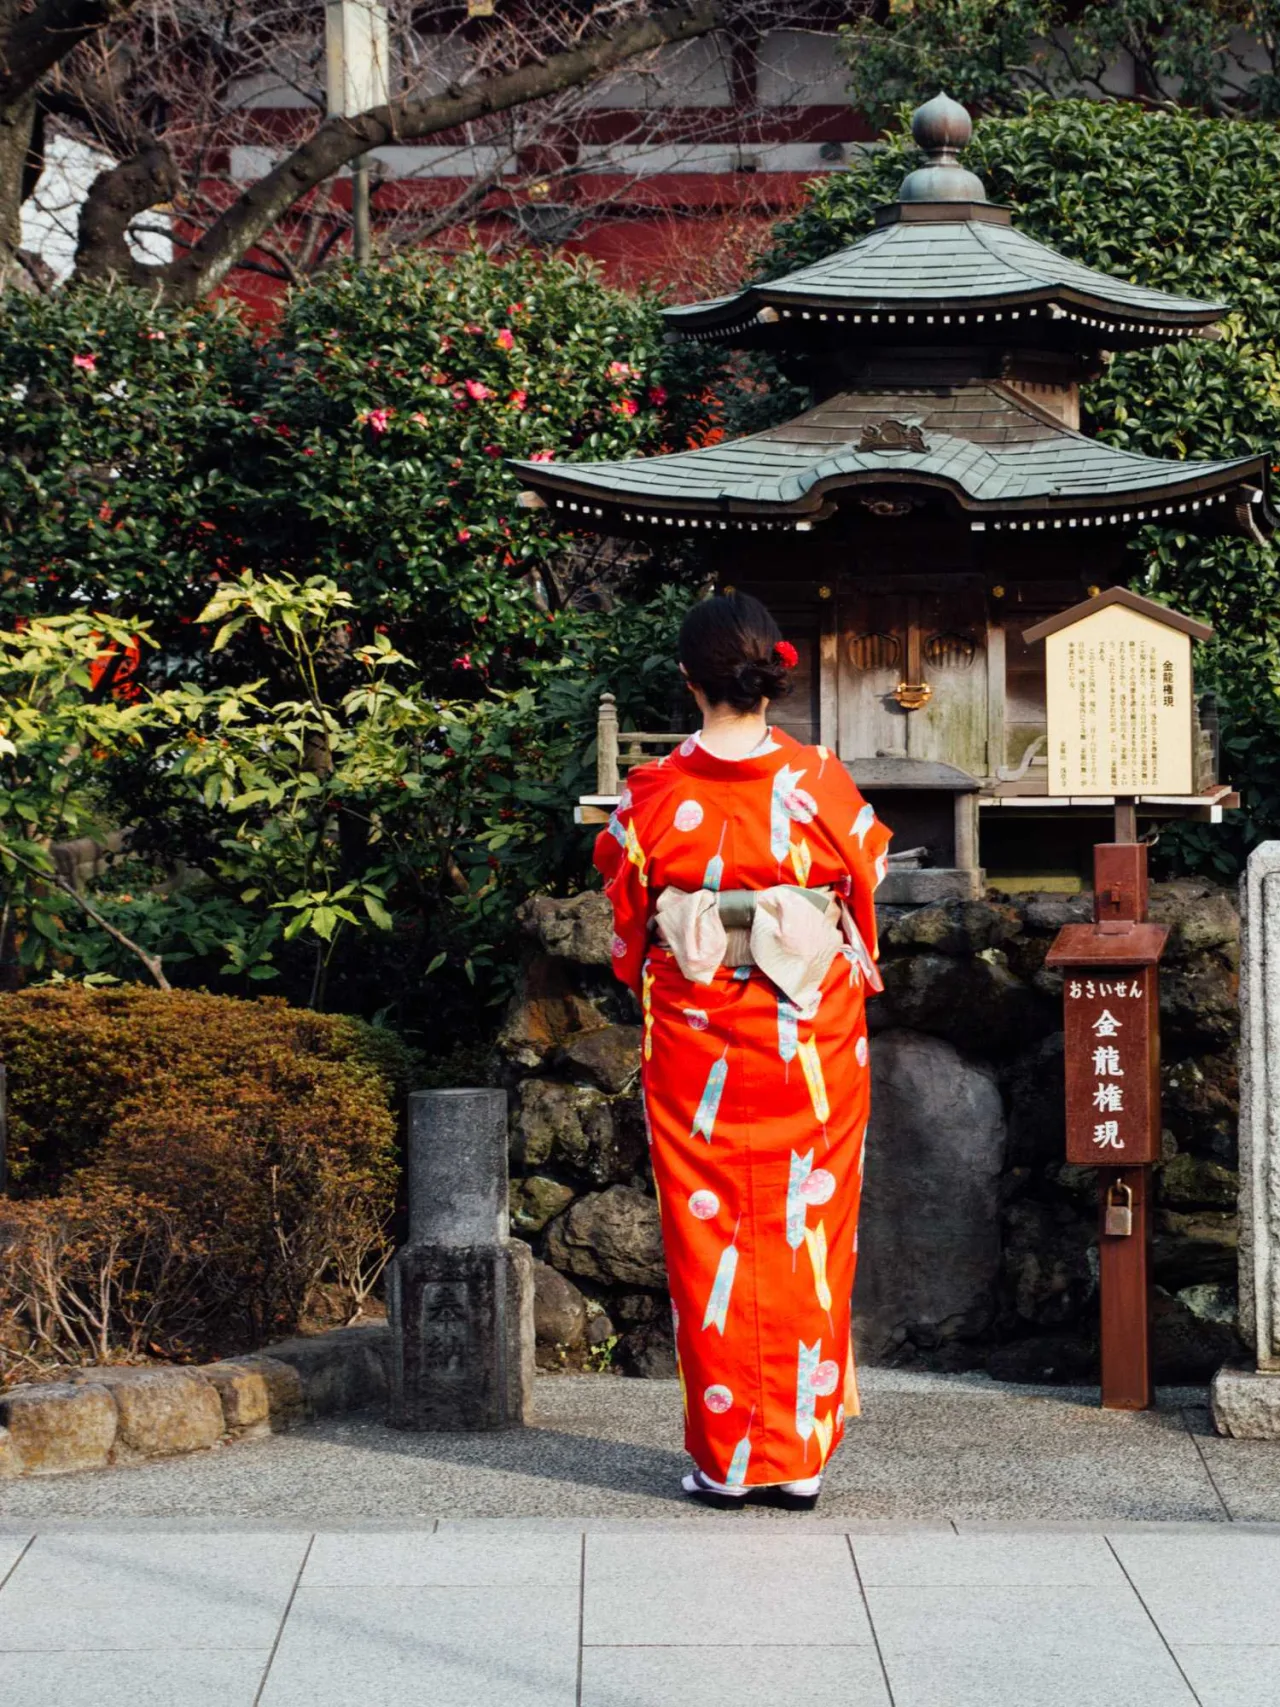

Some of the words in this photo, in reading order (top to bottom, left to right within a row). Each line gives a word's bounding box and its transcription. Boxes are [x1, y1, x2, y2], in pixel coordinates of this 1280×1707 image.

[1162, 659, 1175, 707] 金龍権現
[1069, 980, 1143, 999] おさいせん
[1091, 1009, 1125, 1149] 金龍権現
